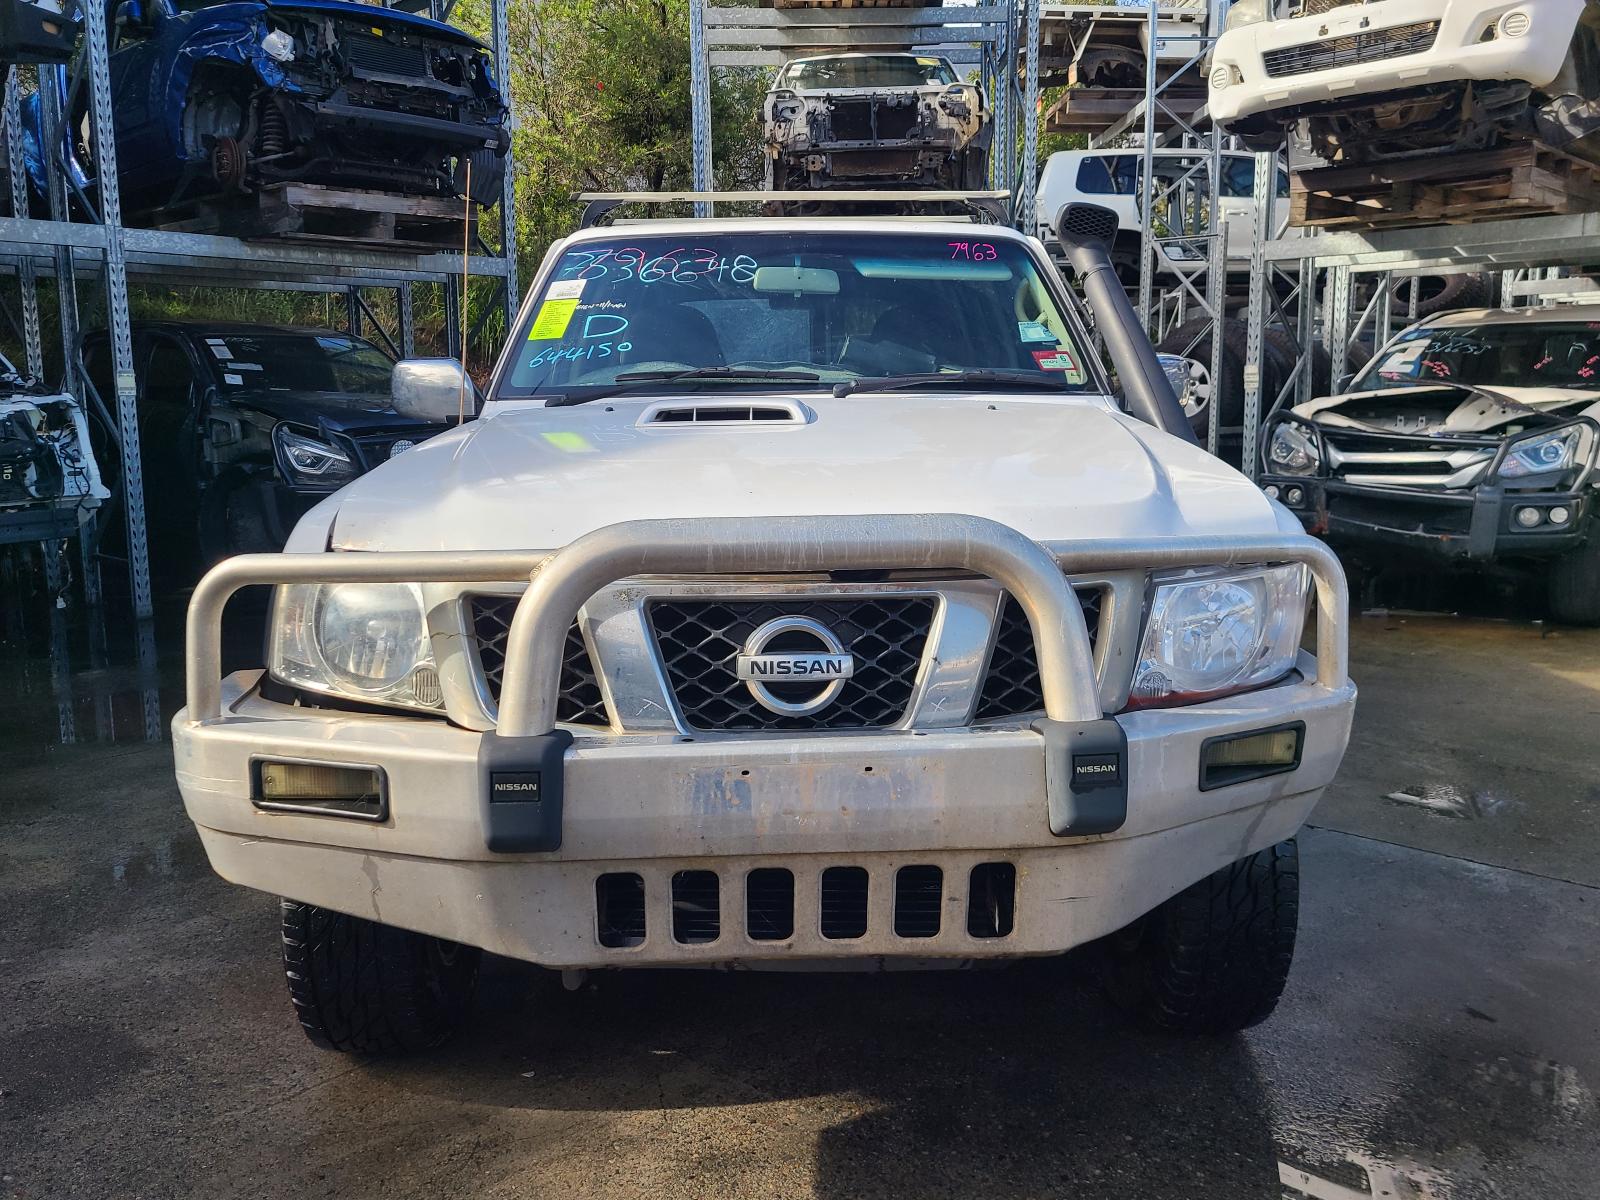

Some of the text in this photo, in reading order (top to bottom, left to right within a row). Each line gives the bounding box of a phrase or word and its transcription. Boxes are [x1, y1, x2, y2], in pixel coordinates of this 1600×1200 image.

[947, 242, 998, 261] 7963
[583, 314, 629, 338] D
[529, 341, 632, 367] 644150
[750, 659, 842, 675] NISSAN
[1076, 764, 1116, 774] NISSAN
[494, 782, 537, 791] NISSAN
